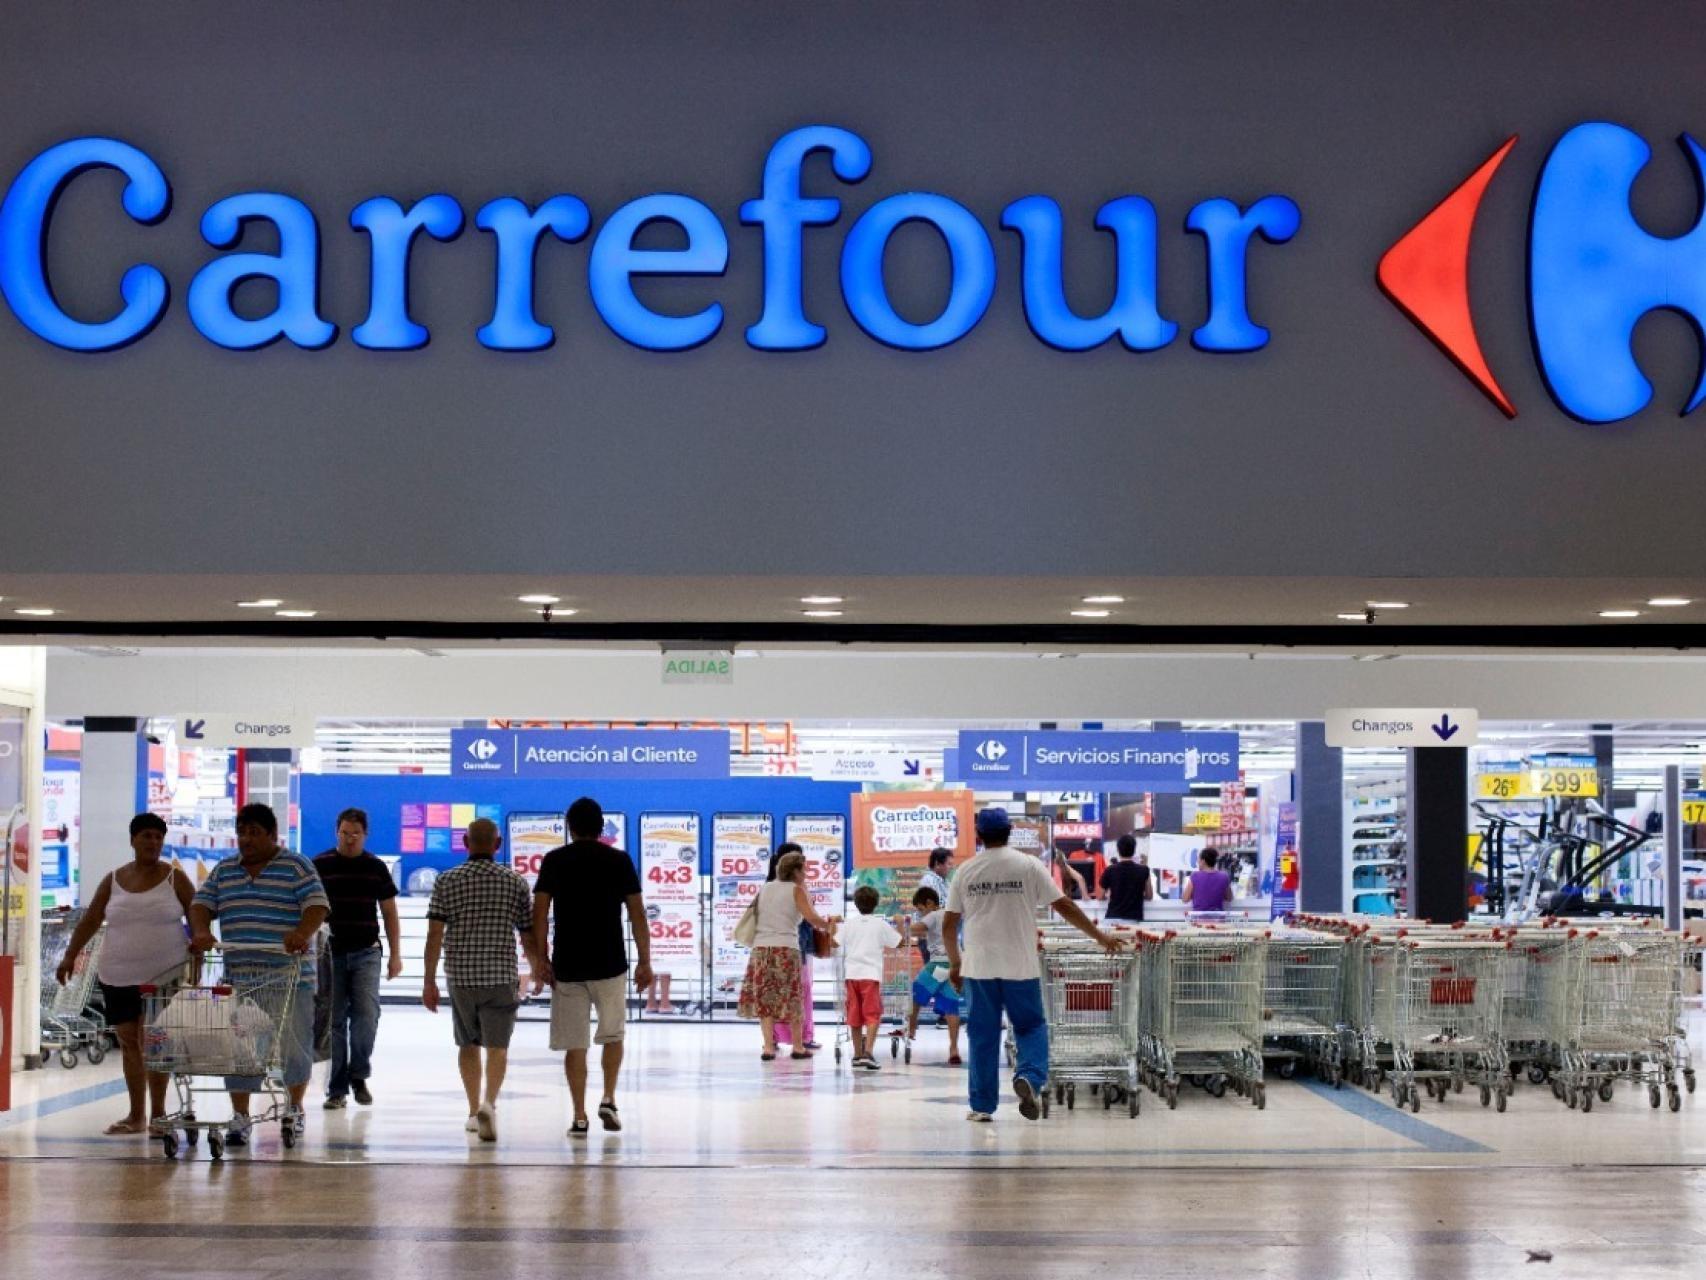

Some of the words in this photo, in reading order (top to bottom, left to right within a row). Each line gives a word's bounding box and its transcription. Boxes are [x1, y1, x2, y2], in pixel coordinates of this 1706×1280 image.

[0, 125, 1301, 352] Carrefour
[235, 722, 291, 736] Changos
[1352, 719, 1413, 734] Changos
[525, 744, 608, 763] Atención
[612, 746, 627, 763] al
[632, 746, 697, 763] Cliente
[1036, 748, 1120, 765] Servicios
[1124, 748, 1230, 765] Financros
[463, 761, 501, 770] Carrefour
[836, 759, 875, 768] Acceso
[972, 763, 1010, 771] Carrefour
[1493, 778, 1508, 796] 26
[1541, 773, 1580, 793] 299
[875, 807, 952, 822] Carrefour
[1686, 804, 1704, 822] 17
[894, 823, 924, 833] lleva
[648, 866, 692, 884] 4x3
[738, 884, 760, 895] 60
[650, 921, 693, 938] 3x2
